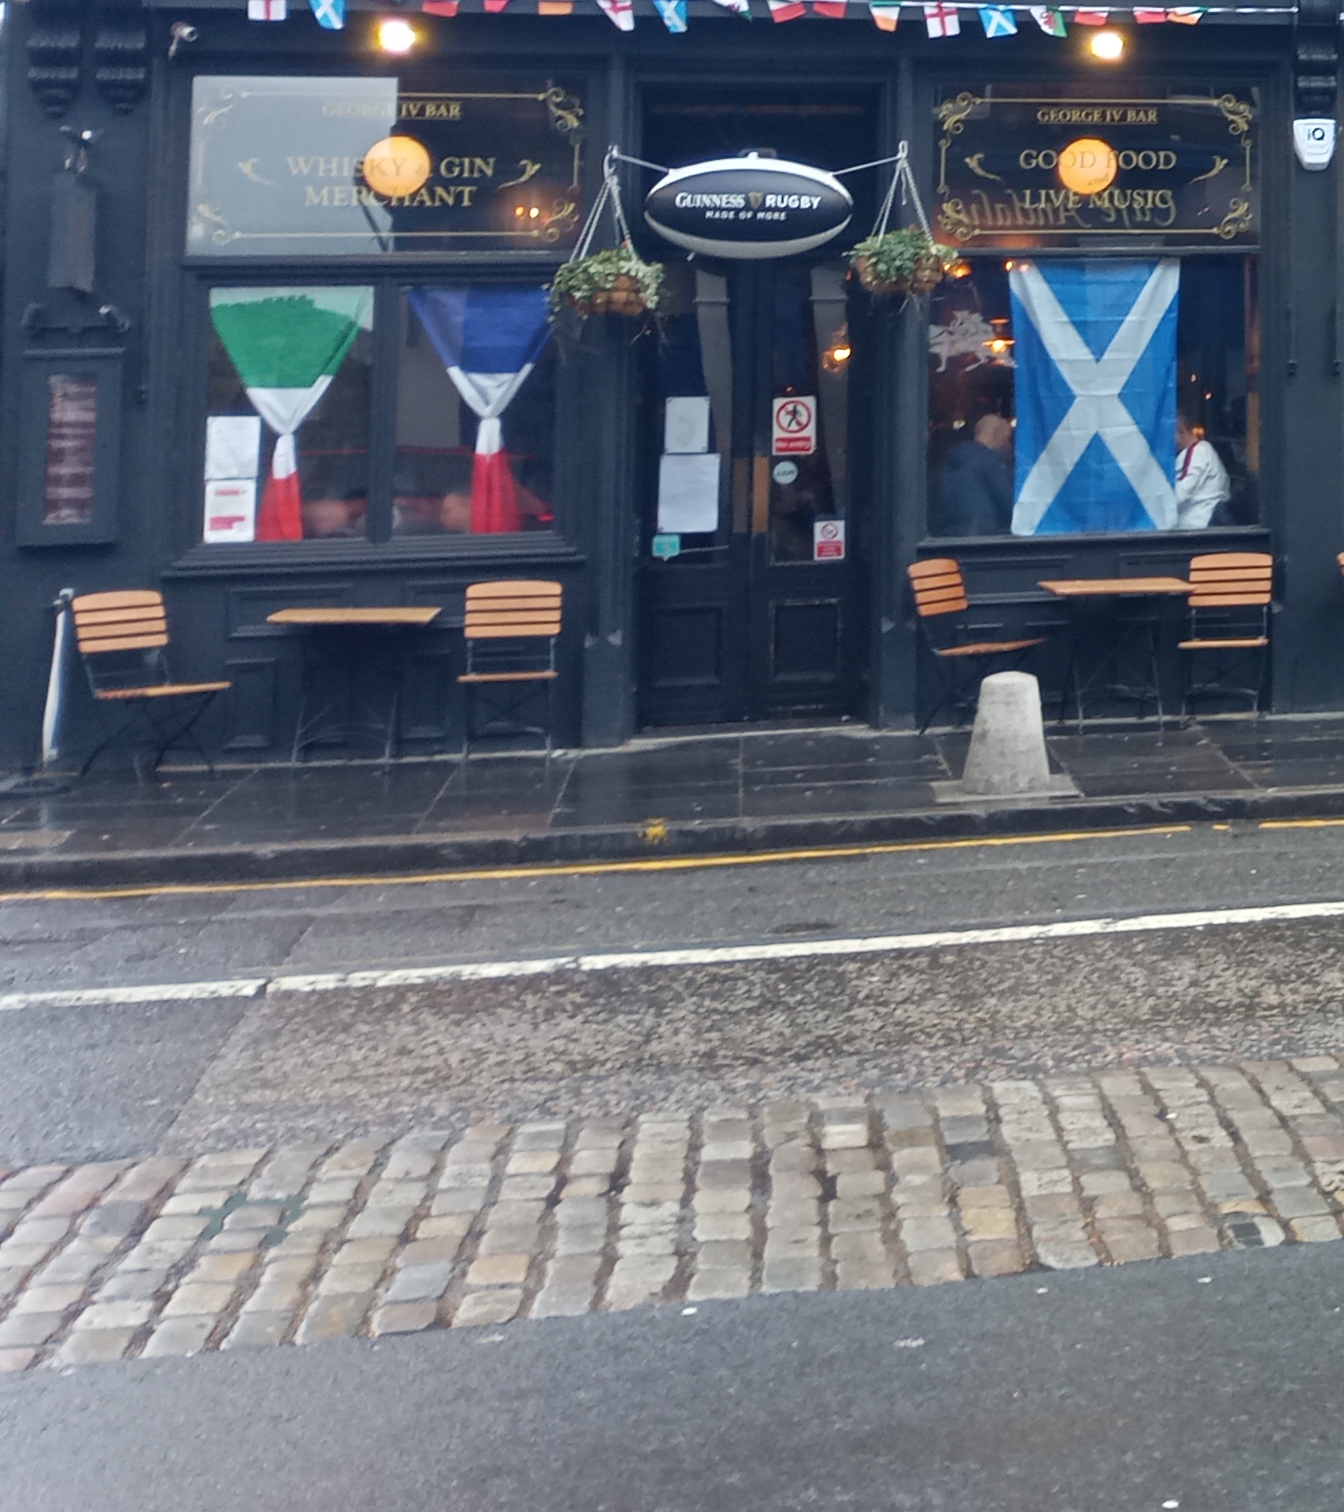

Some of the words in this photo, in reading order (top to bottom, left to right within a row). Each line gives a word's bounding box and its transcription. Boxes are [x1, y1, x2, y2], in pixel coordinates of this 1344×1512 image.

[401, 103, 421, 117] IV
[425, 102, 462, 118] BAR
[1036, 108, 1102, 122] GEORGE
[1105, 109, 1123, 122] IV
[1126, 108, 1158, 123] BAR
[439, 156, 496, 178] GIN
[1019, 149, 1096, 170] GOOD
[1106, 150, 1177, 170] FOOD
[675, 191, 746, 209] GUINNESS
[765, 194, 823, 210] RUGBY
[1022, 188, 1083, 209] LIVE
[1089, 188, 1174, 209] MUSIC
